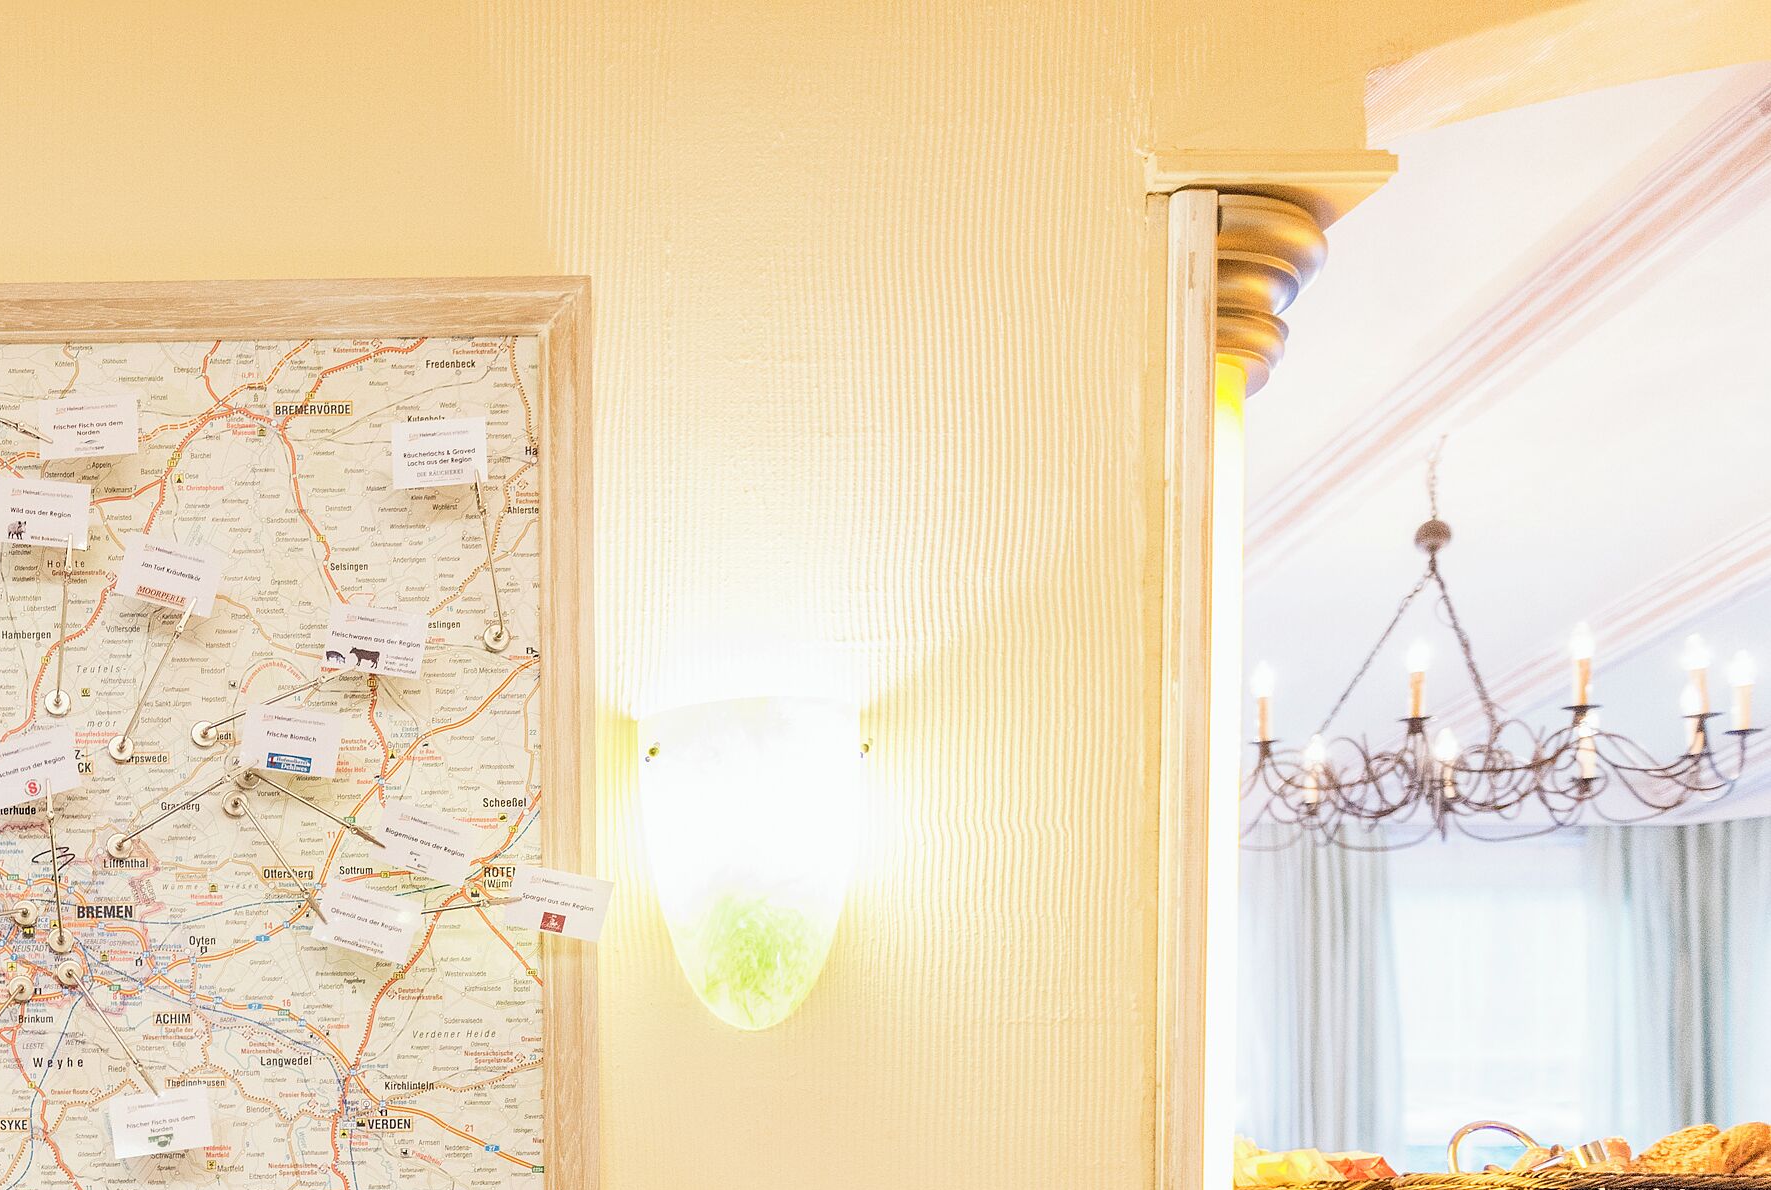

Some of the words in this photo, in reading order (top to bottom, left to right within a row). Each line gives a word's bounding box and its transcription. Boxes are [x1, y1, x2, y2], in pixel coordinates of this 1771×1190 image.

[426, 360, 475, 369] Fredenbeck
[275, 404, 350, 416] BREMERVÖRDE
[330, 563, 368, 572] Selsingen
[137, 585, 186, 603] MOORPERLE
[427, 620, 460, 630] eslingen
[2, 631, 51, 640] Hambergen
[332, 631, 372, 641] Fleischwaren
[387, 637, 397, 645] der
[399, 640, 420, 648] Region
[267, 730, 288, 738] Frische
[290, 734, 316, 742] Biomilch
[44, 756, 65, 765] Region
[127, 754, 168, 764] rpswede
[483, 797, 527, 808] Scheeßel
[386, 827, 418, 842] Biogemüse
[444, 846, 465, 857] Region
[104, 859, 149, 868] Lilienthal
[263, 868, 313, 879] Ottersberg
[339, 865, 373, 875] Sottrum
[522, 893, 546, 902] Spargel
[572, 902, 594, 911] Region
[78, 906, 133, 918] BREMEN
[331, 908, 356, 919] Olivenöl
[381, 923, 402, 933] Region
[189, 936, 216, 947] Oyten
[18, 1015, 53, 1024] Brinkum
[156, 1014, 190, 1024] ACHIM
[412, 1030, 462, 1038] Verdener
[466, 1030, 496, 1038] Heide
[33, 1058, 83, 1068] Weyhe
[260, 1056, 312, 1066] Langwedel
[384, 1082, 434, 1090] Kirchlinteln
[0, 1119, 27, 1130] SYKE
[368, 1119, 411, 1129] VERDEN
